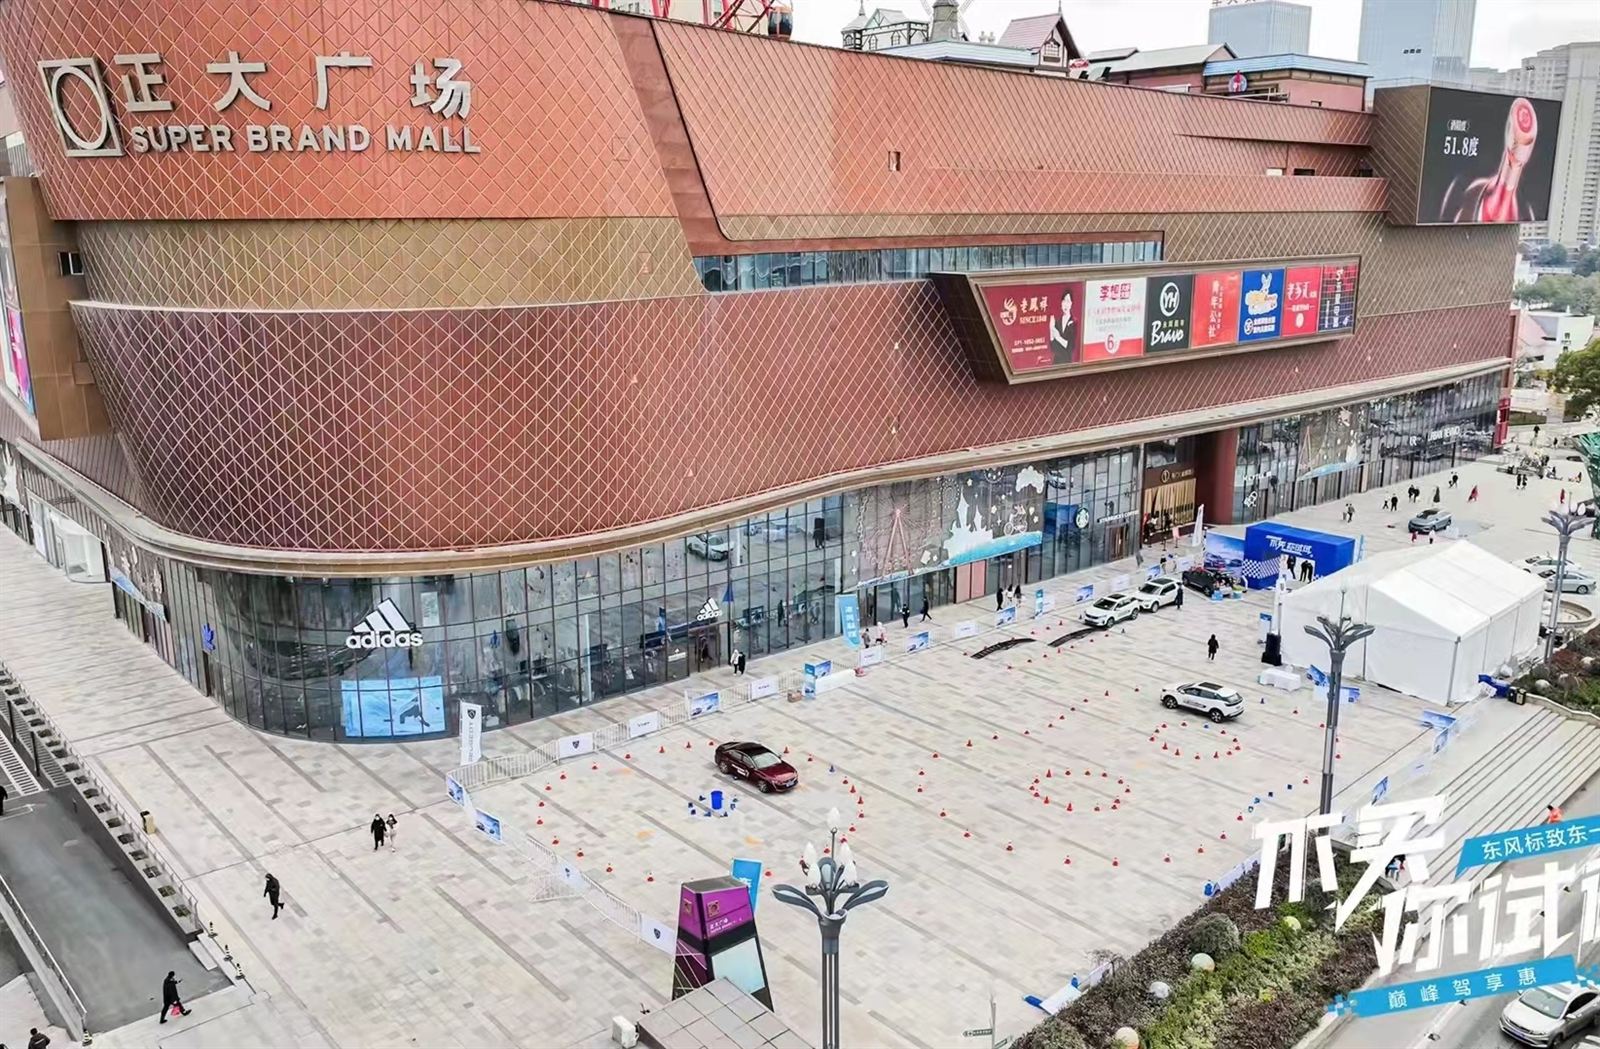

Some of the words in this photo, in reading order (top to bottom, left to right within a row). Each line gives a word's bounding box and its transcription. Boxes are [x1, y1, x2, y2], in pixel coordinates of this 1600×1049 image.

[113, 51, 472, 119] 正大广场
[130, 124, 235, 153] SUPER
[246, 124, 371, 153] BRAND
[386, 124, 481, 153] MALL
[1443, 136, 1479, 156] 51.8度
[1151, 320, 1184, 346] Bravo
[696, 610, 723, 621] adidas
[346, 630, 423, 648] adidas
